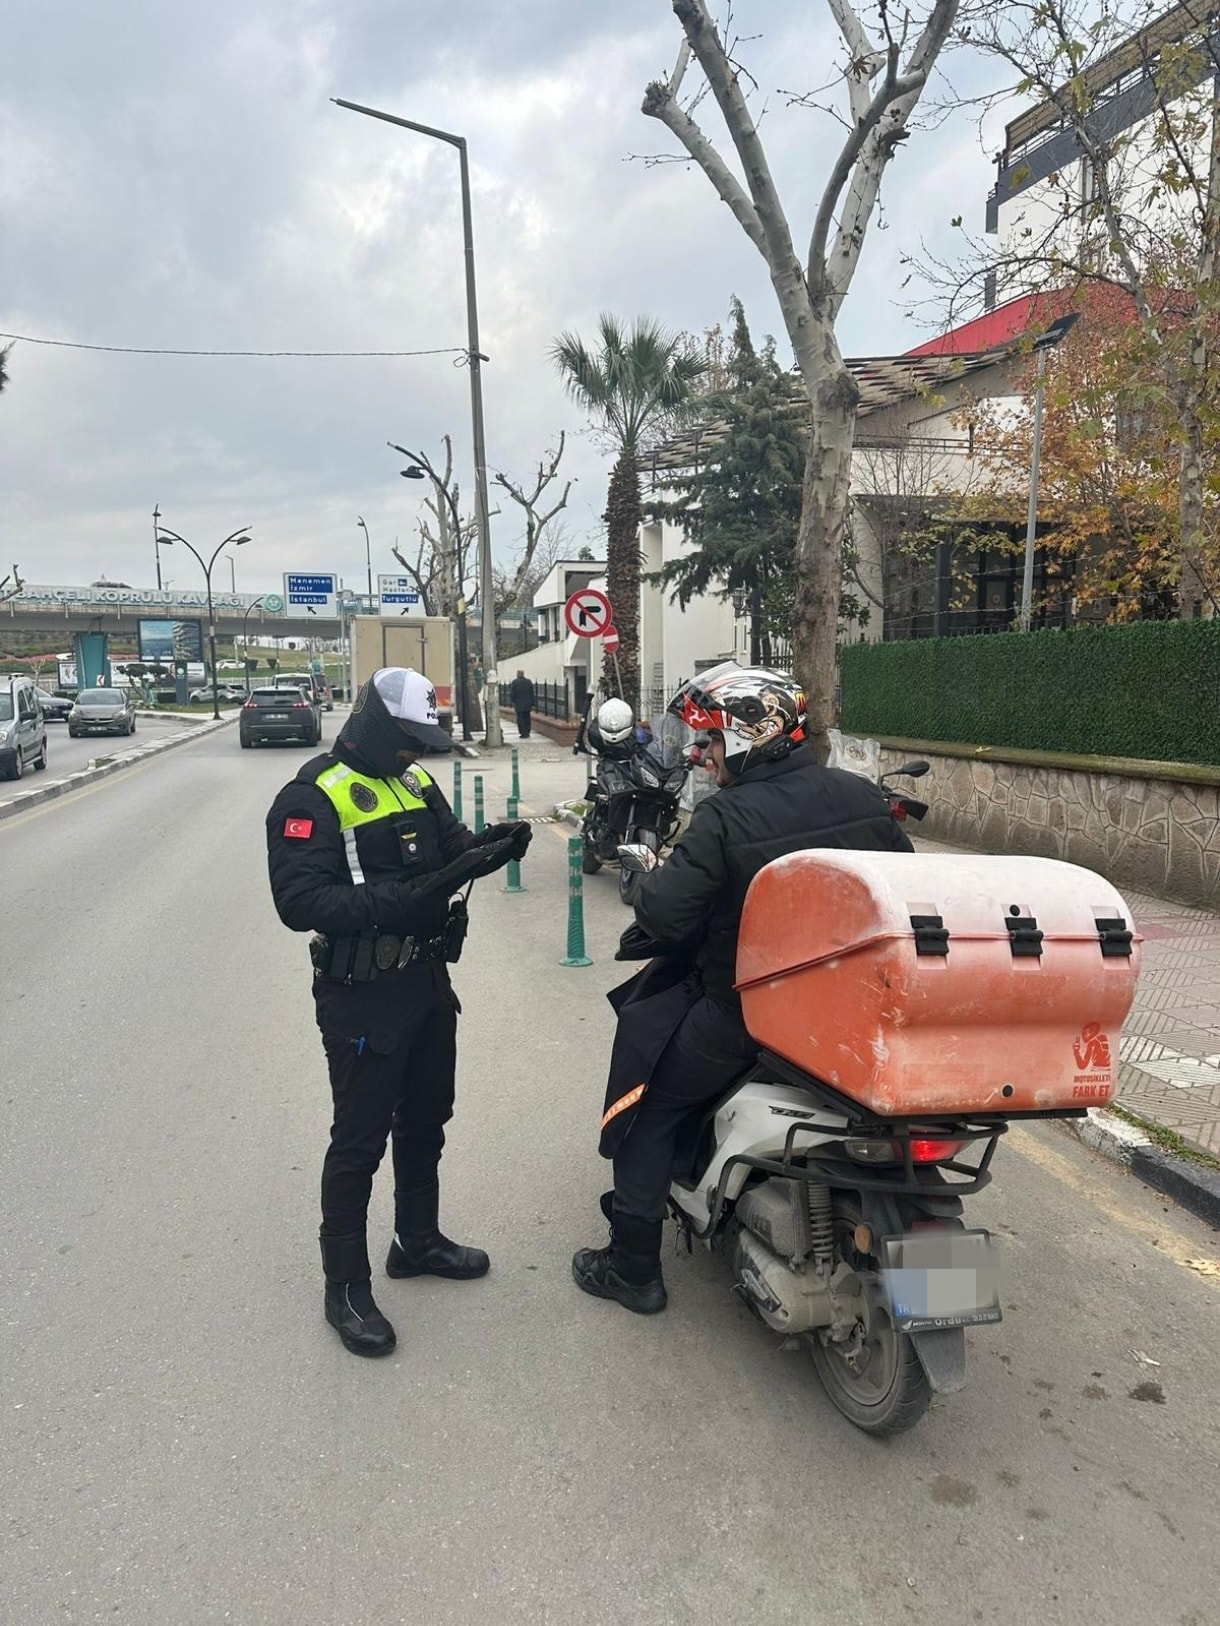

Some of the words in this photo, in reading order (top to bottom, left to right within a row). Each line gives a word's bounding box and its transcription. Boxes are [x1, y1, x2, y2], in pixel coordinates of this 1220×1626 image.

[290, 577, 331, 585] Menemen
[96, 590, 173, 604] KÖPRÜLÜ
[178, 593, 245, 608] KAVŞAĞI
[1072, 1086, 1096, 1098] FARK
[1100, 1085, 1110, 1097] ET
